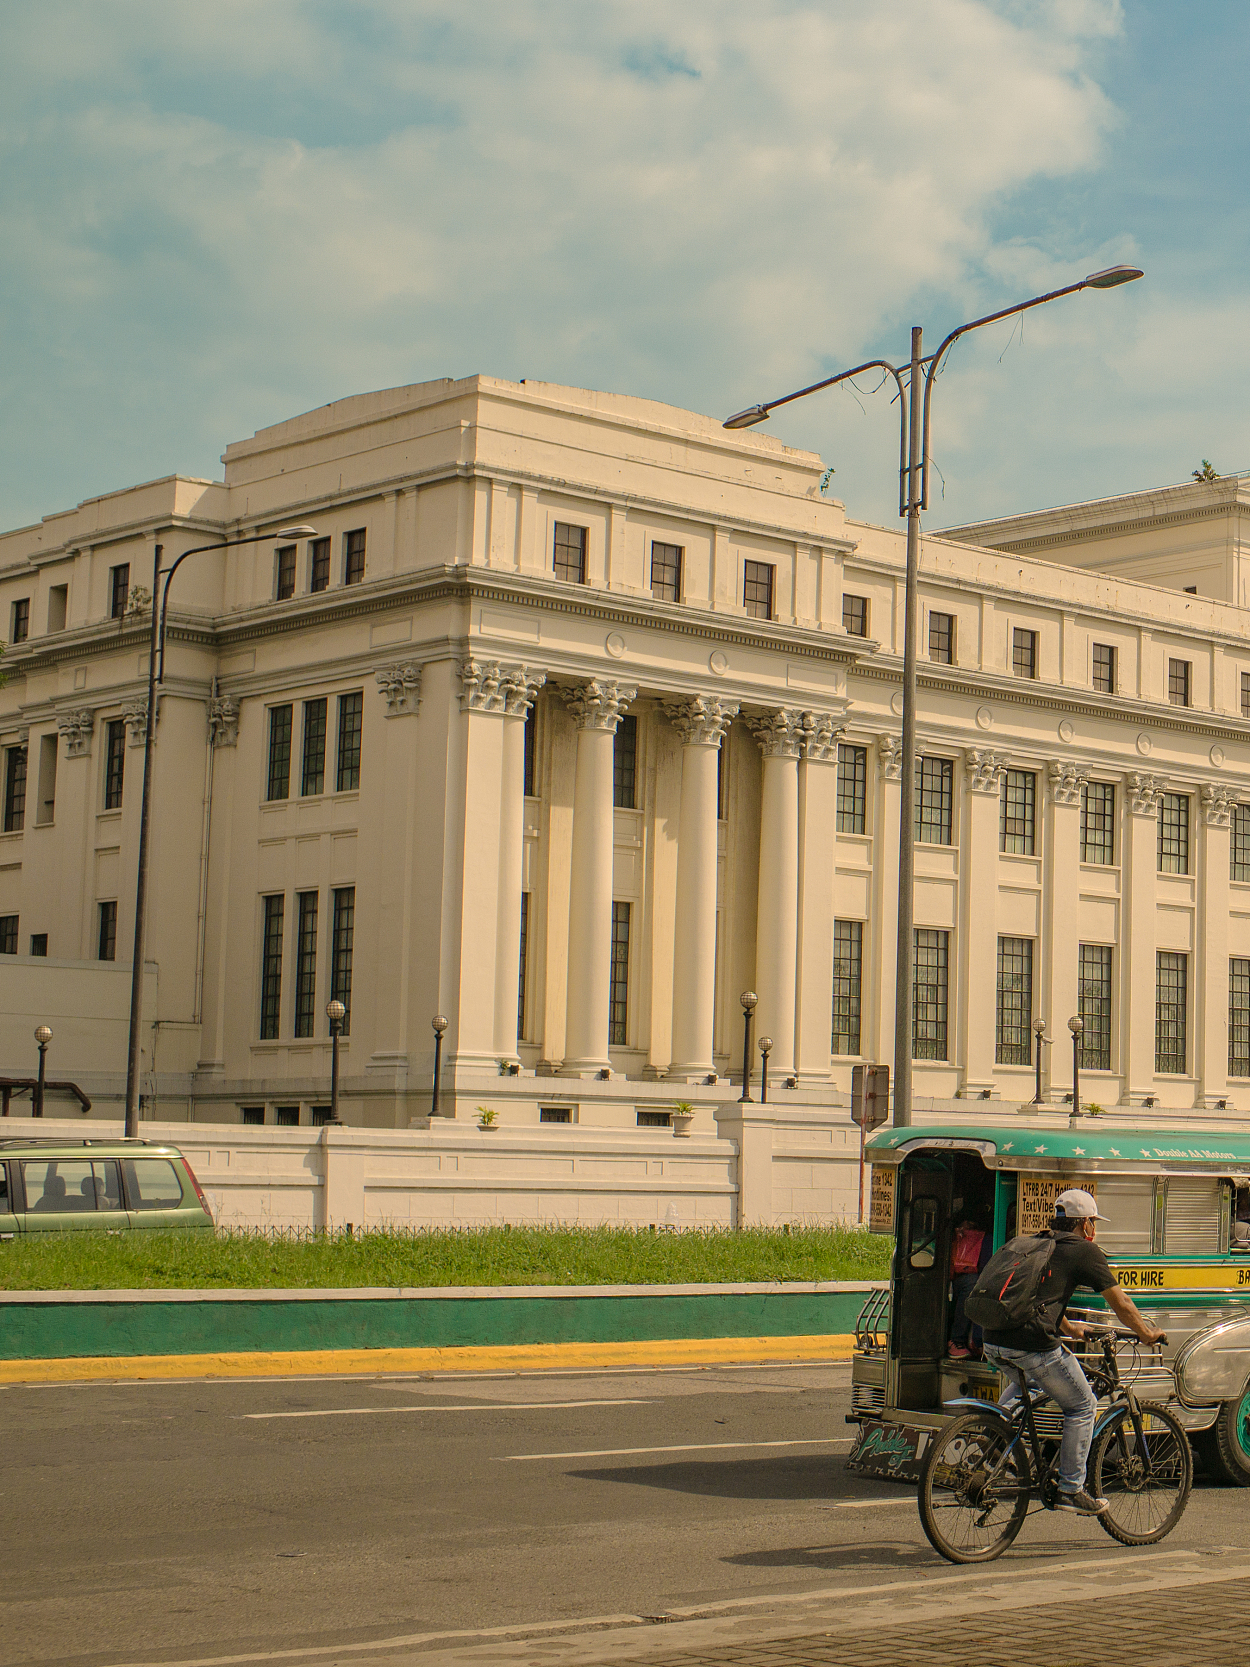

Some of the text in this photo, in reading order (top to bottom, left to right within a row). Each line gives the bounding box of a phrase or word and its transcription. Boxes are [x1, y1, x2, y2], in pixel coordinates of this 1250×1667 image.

[1153, 1148, 1236, 1159] Double AA Motors
[1022, 1182, 1039, 1196] LTFRB
[1040, 1183, 1053, 1197] 24/7
[1022, 1198, 1054, 1212] Text/Vibe
[1117, 1271, 1164, 1286] FOR HIRE
[856, 1428, 916, 1460] Pride
[888, 1450, 913, 1469] of
